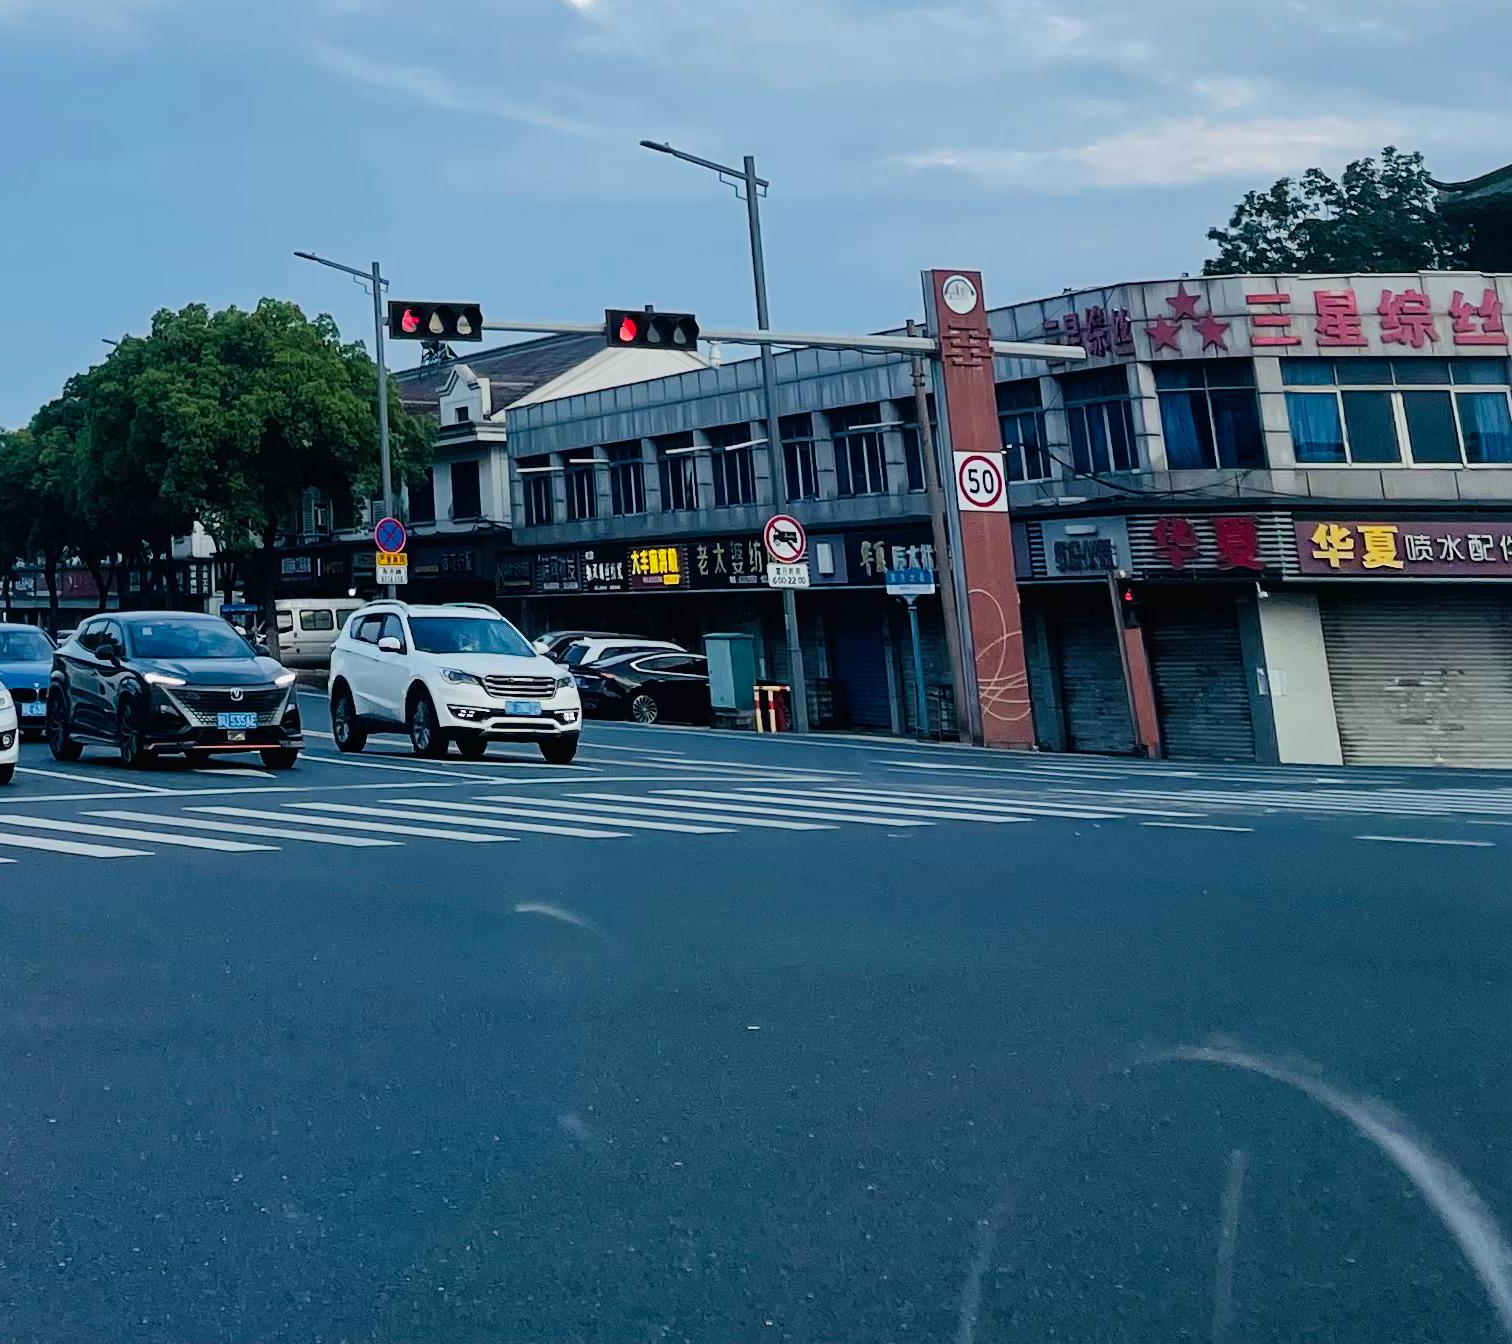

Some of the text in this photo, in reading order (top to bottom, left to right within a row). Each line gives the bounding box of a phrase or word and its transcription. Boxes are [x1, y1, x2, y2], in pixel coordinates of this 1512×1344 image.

[1245, 288, 1509, 349] 三星综丝
[968, 468, 994, 495] 50
[695, 539, 775, 576] 老太婆纺
[1152, 516, 1265, 571] 华夏
[1311, 522, 1405, 570] 华夏
